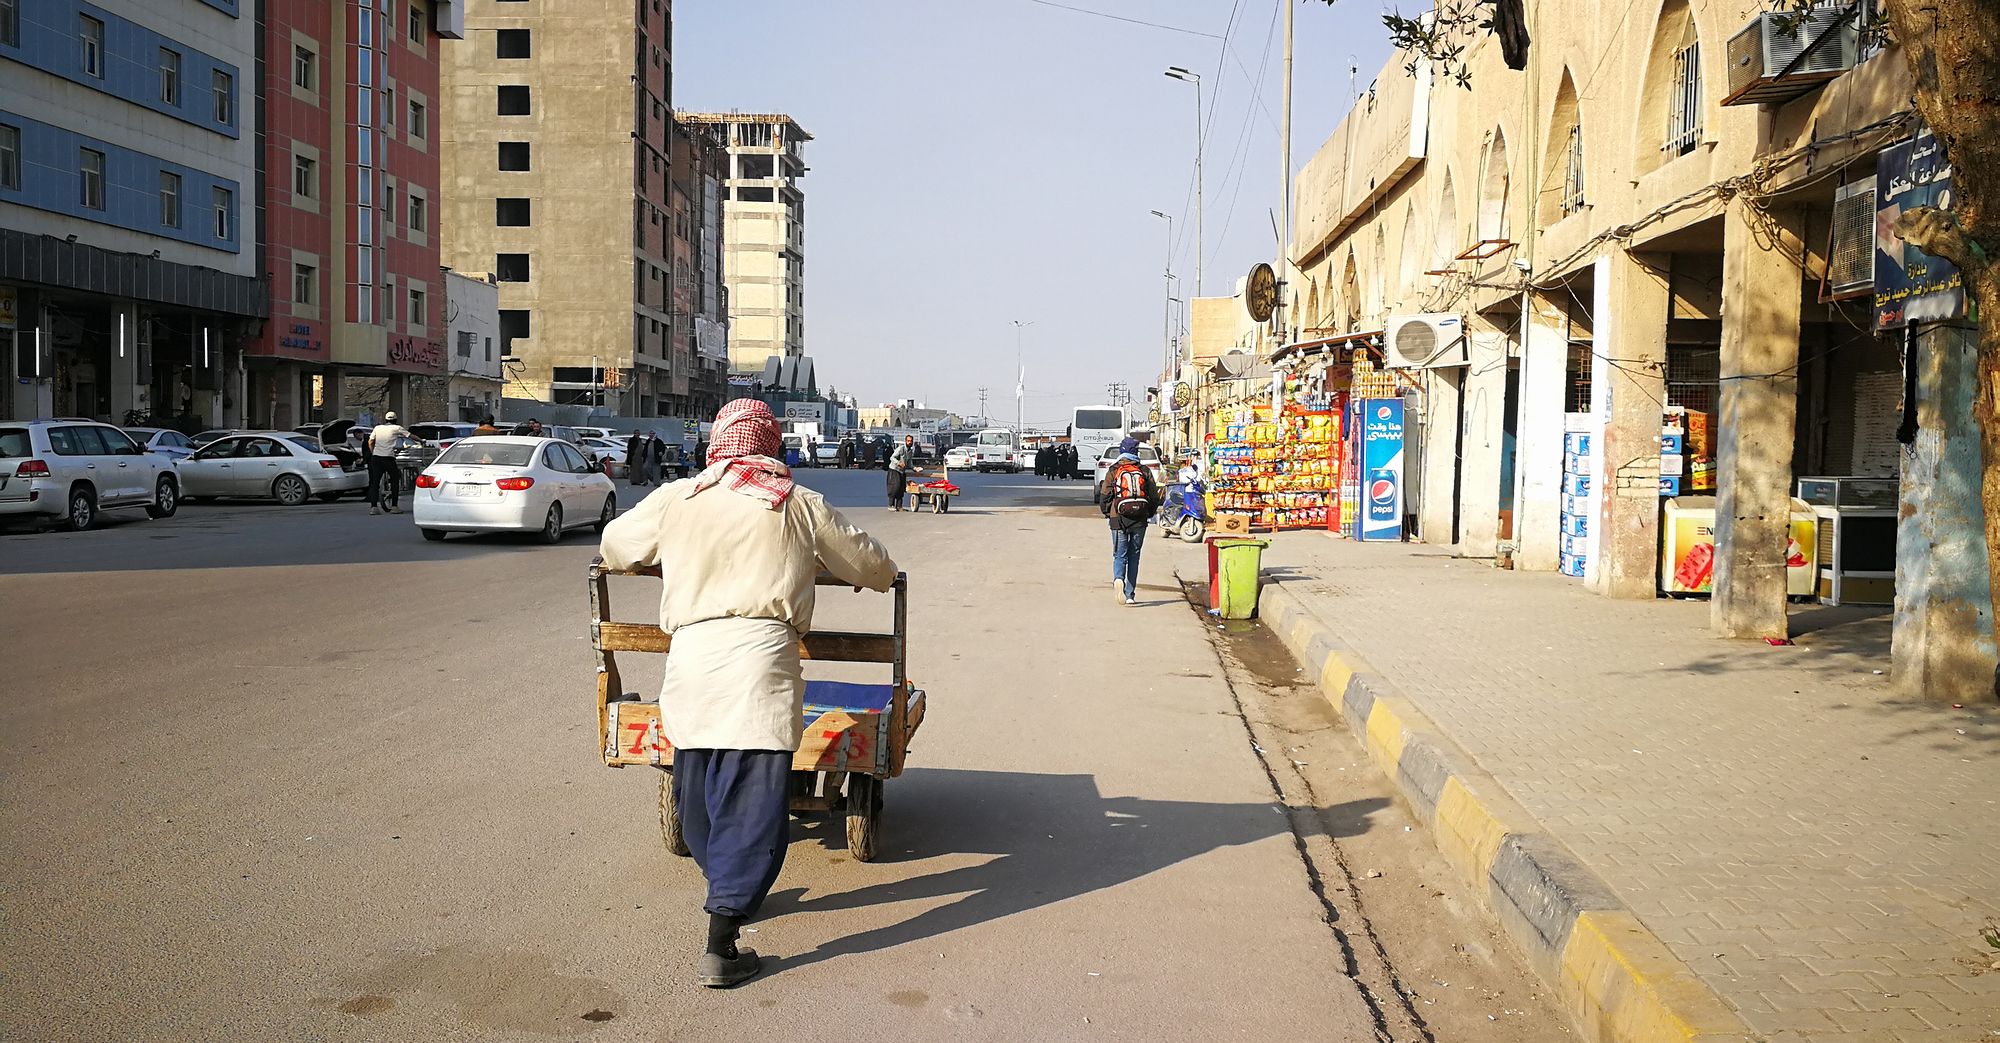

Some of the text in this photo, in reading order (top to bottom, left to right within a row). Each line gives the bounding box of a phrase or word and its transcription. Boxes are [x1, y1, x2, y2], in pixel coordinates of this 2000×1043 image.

[1367, 422, 1402, 433] هذا وقت
[1372, 505, 1394, 514] pepsi
